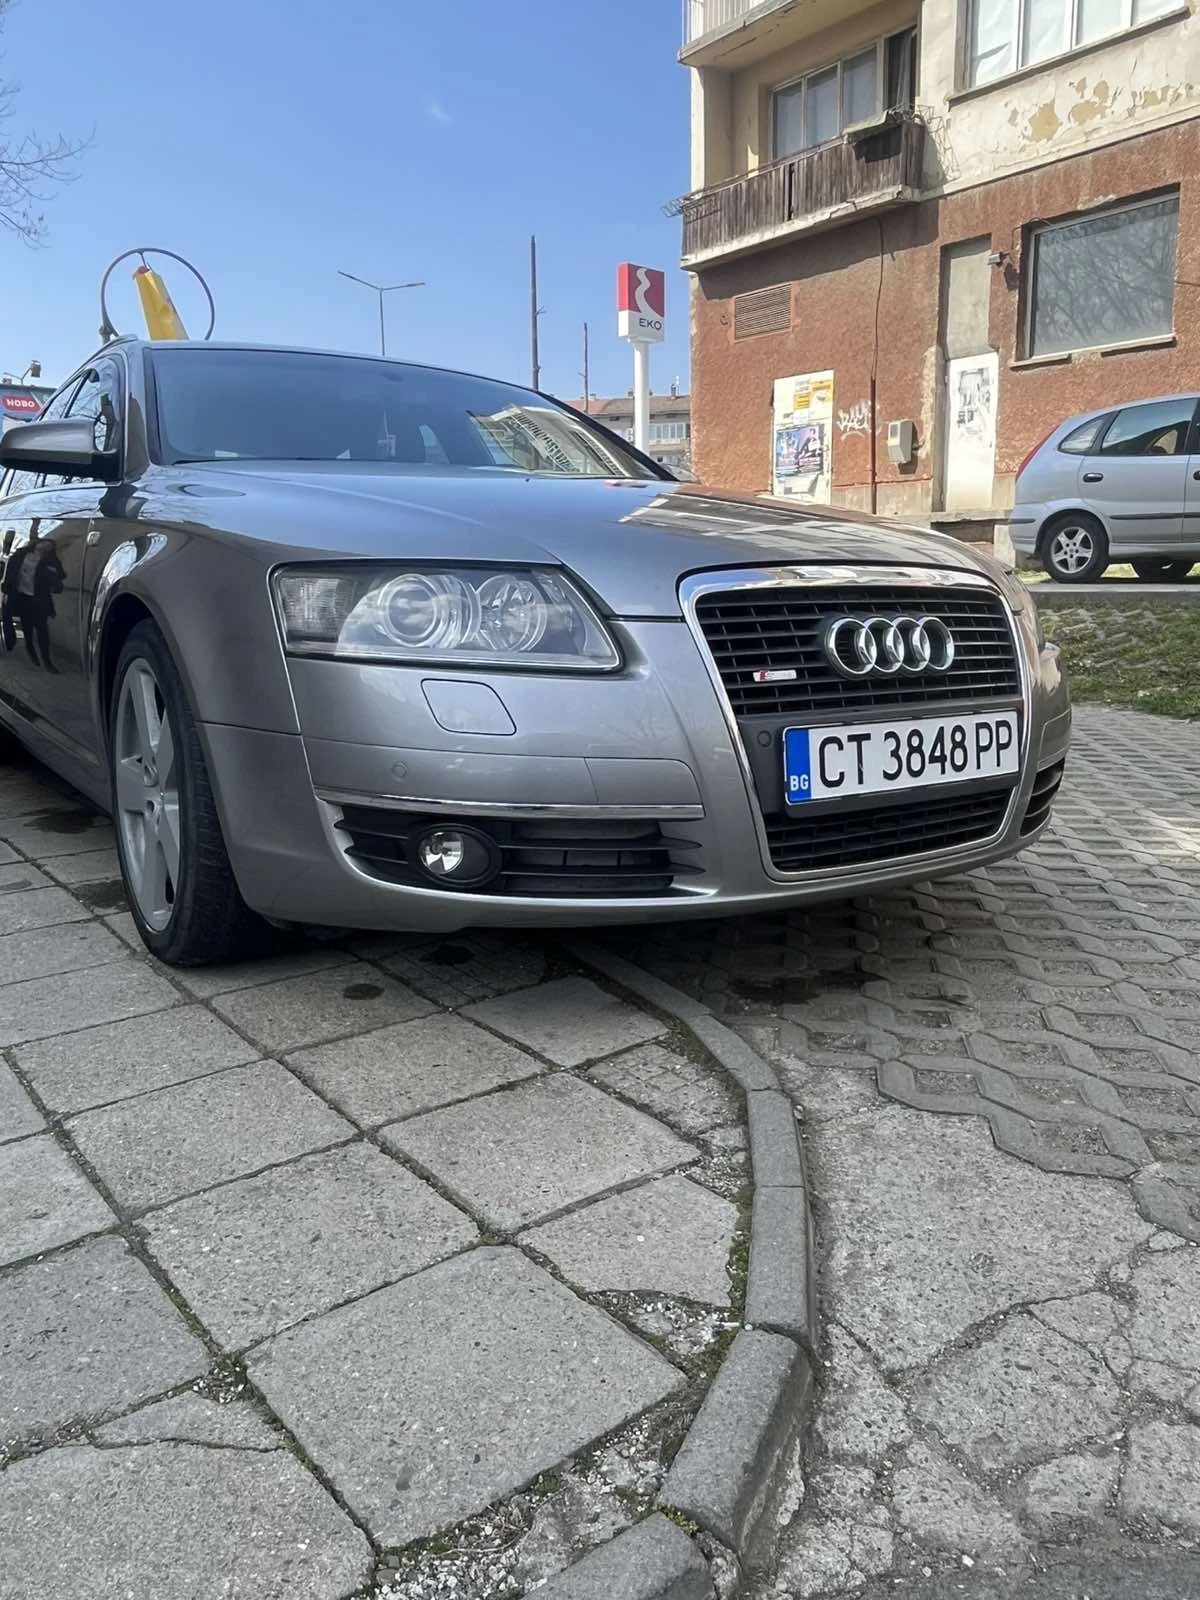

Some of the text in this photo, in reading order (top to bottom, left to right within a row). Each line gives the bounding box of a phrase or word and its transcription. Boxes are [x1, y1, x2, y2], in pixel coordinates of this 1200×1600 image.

[639, 317, 662, 330] EKO
[818, 719, 1012, 788] CT 3848 PP
[790, 774, 809, 791] BG
